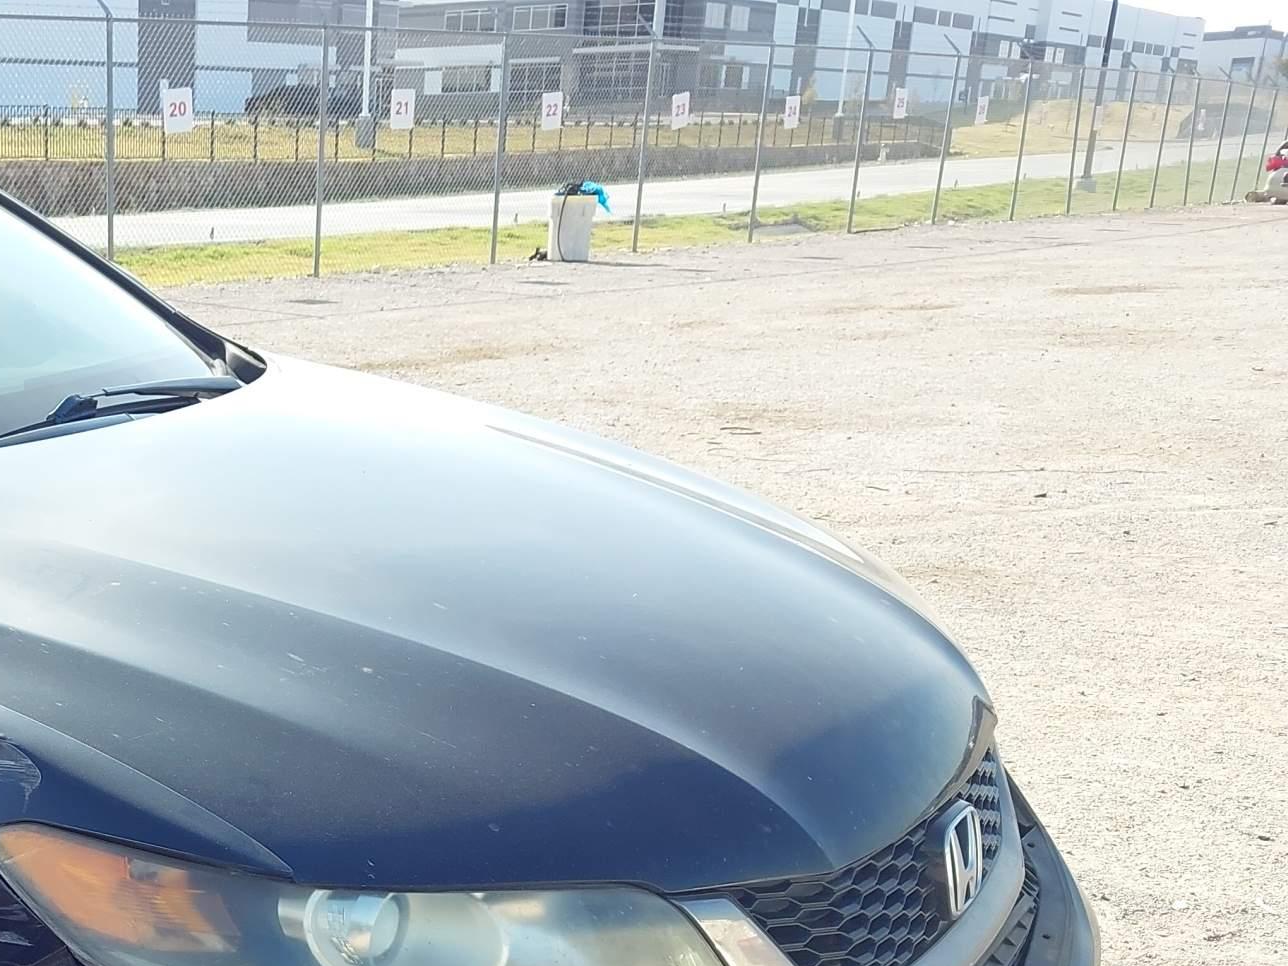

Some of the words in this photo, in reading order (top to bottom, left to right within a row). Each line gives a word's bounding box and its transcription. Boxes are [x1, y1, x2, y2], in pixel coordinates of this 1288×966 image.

[169, 101, 187, 118] 20
[396, 101, 409, 115] 21
[546, 103, 558, 118] 22
